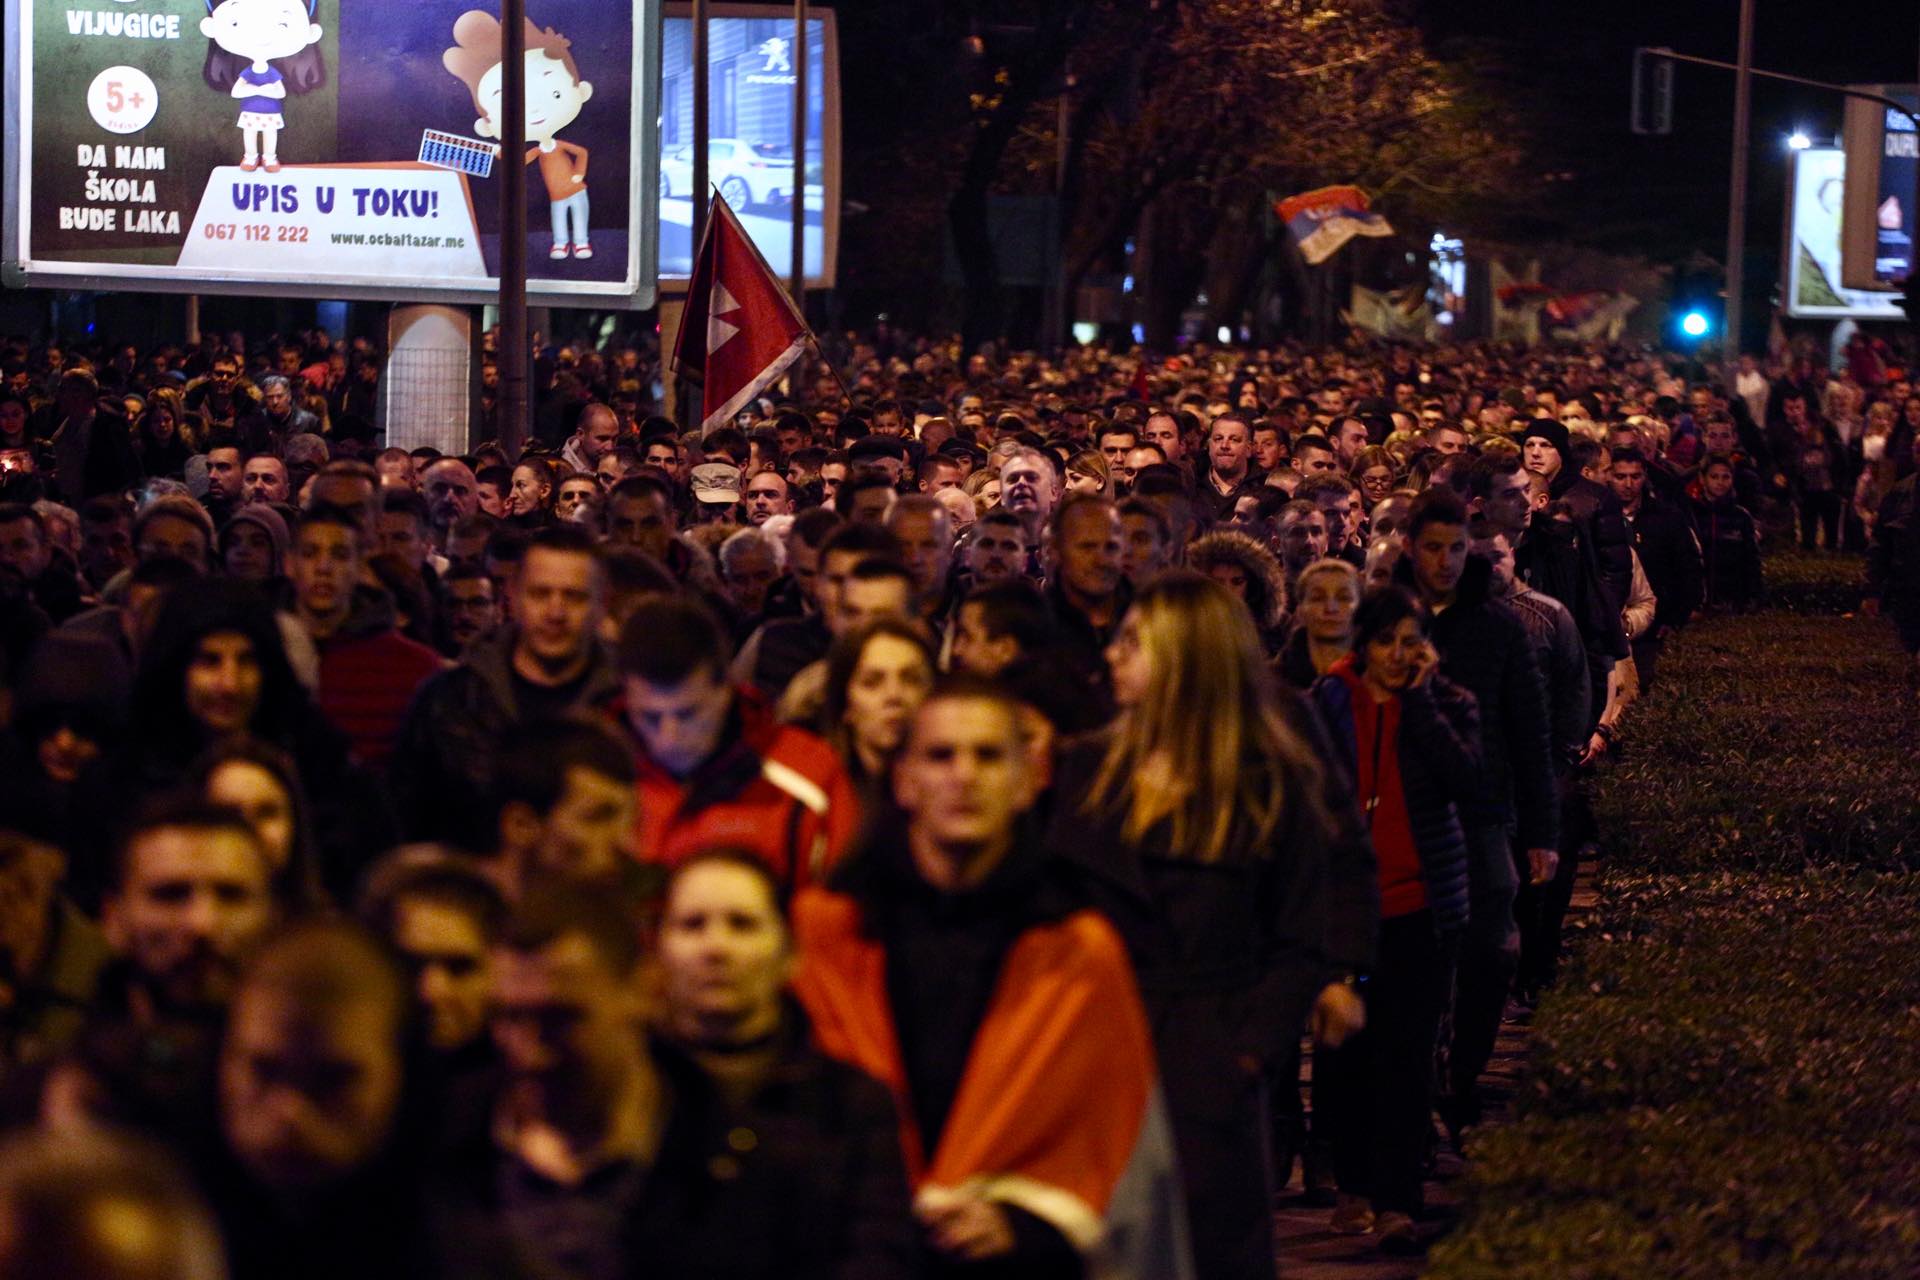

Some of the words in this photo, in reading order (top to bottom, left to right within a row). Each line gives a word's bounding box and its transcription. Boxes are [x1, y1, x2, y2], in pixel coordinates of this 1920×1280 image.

[67, 10, 180, 39] VIJUGICE
[106, 81, 144, 113] 5+
[77, 144, 107, 168] DA
[115, 146, 165, 170] NAM
[85, 170, 156, 203] ŠKOLA
[232, 183, 298, 213] UPIS
[316, 186, 335, 214] U
[352, 188, 438, 218] TOKU!
[59, 207, 116, 231] BUDE
[124, 209, 180, 234] LAKA
[204, 223, 236, 240] 067
[244, 225, 270, 241] 112
[278, 226, 309, 243] 222
[331, 233, 465, 248] www.ocbaltazar.me
